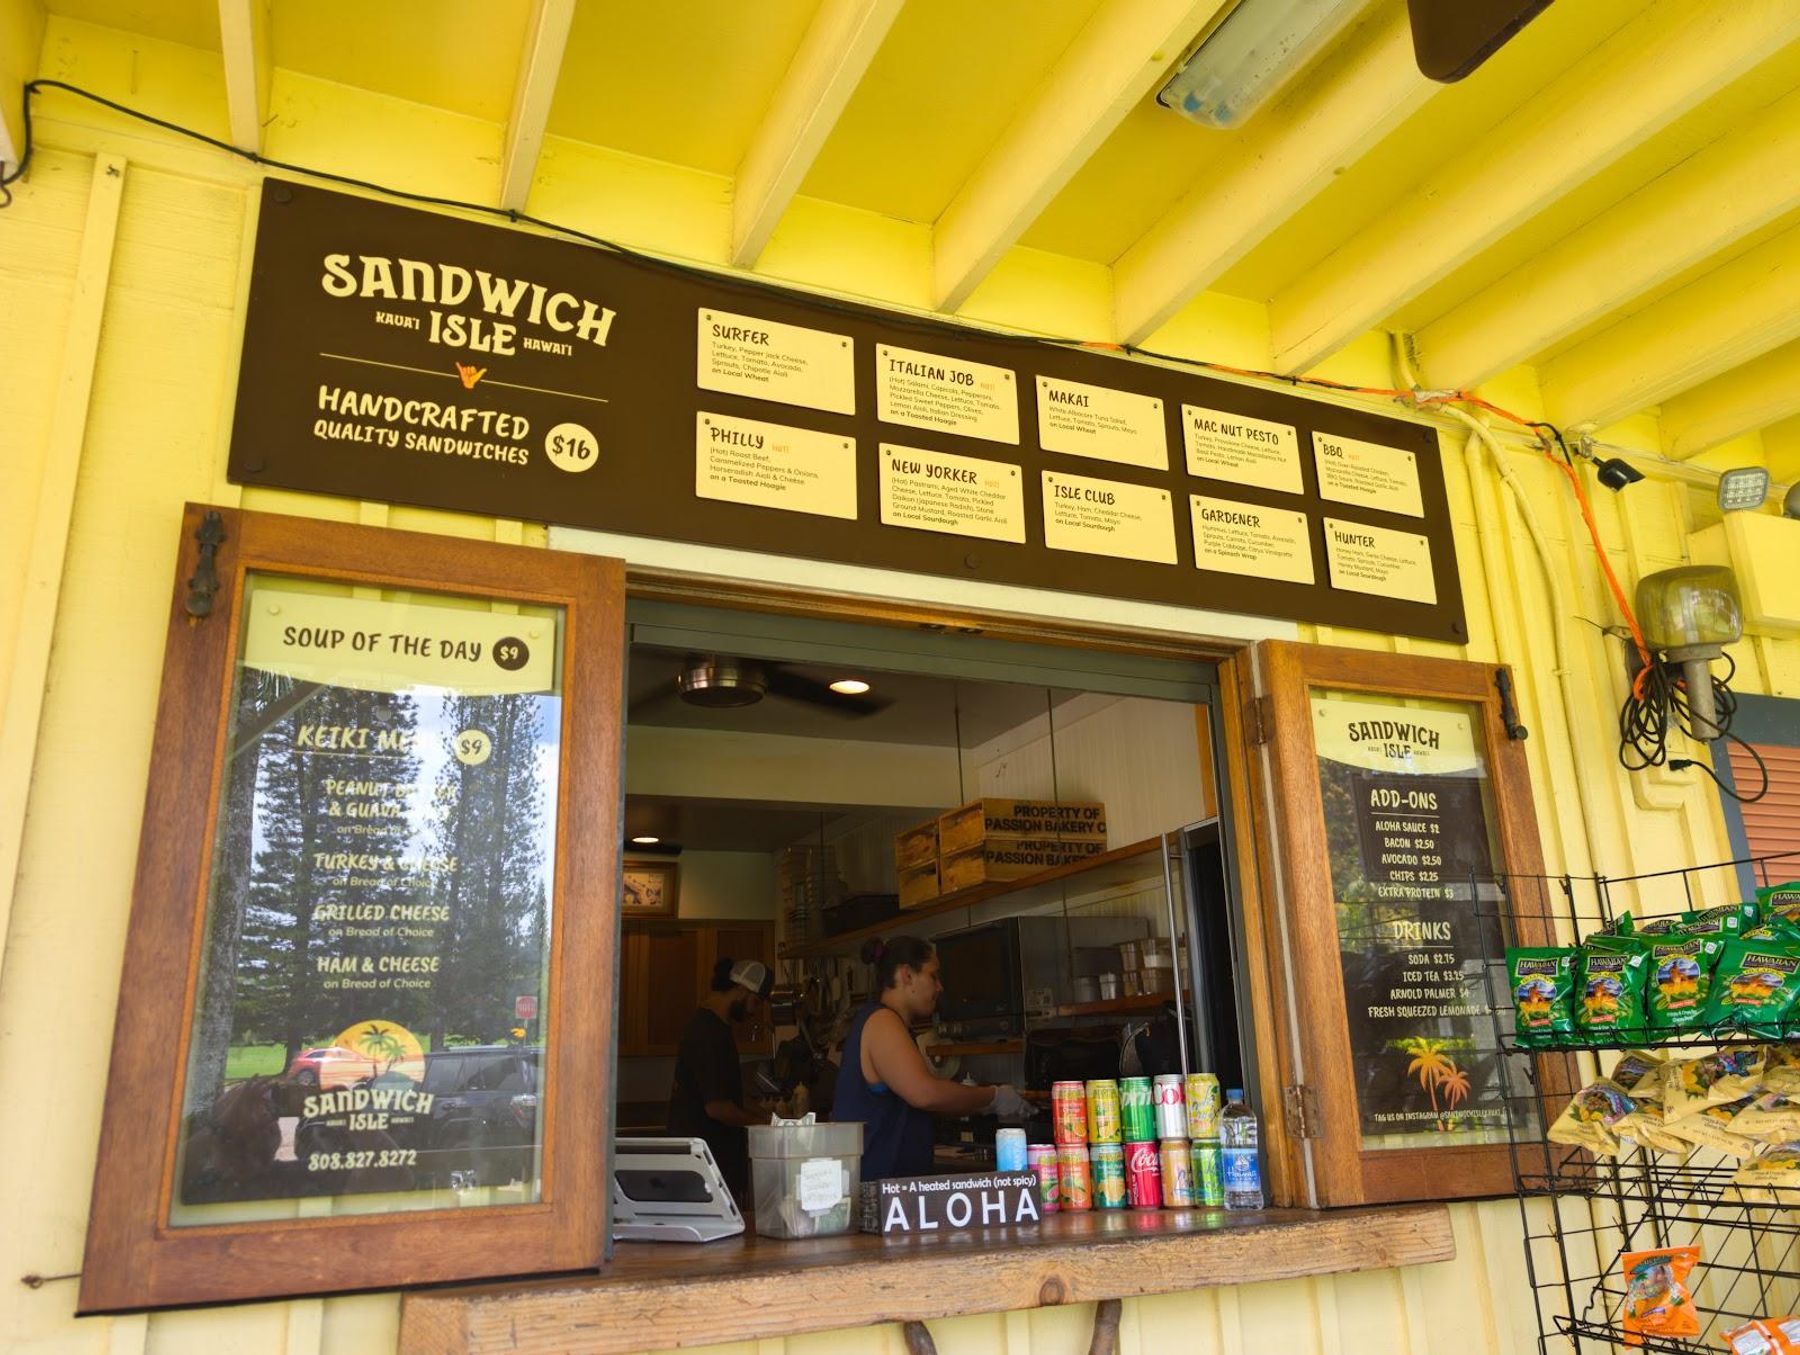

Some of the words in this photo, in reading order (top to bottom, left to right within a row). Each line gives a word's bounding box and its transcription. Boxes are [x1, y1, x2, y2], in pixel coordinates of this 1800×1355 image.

[322, 253, 616, 347] SANDWICH
[428, 310, 516, 356] ISLE
[712, 322, 769, 346] SURFER
[723, 368, 742, 377] Local
[744, 372, 768, 382] Wheat
[889, 357, 944, 381] ITALIAN
[949, 369, 973, 386] JOB
[1048, 388, 1089, 408] MAKAI
[318, 385, 530, 441] HANDCRAFTED
[710, 426, 763, 449] PHILLY
[1193, 417, 1217, 433] MAC
[1219, 422, 1243, 438] NUT
[1245, 427, 1278, 445] PESTO
[314, 420, 400, 448] QUALITY
[404, 432, 529, 466] SANDWICHES
[551, 434, 590, 460] $16
[1322, 443, 1343, 459] BBQ
[891, 457, 920, 475] NEW
[926, 463, 977, 484] YORKER
[710, 473, 719, 481] on
[728, 476, 757, 487] Toasted
[760, 480, 785, 491] Hoagie
[1054, 484, 1080, 500] ISLE
[1084, 489, 1115, 505] CLUB
[893, 510, 901, 518] on
[903, 511, 920, 520] Local
[923, 514, 958, 526] Sourdough
[1055, 517, 1063, 525] on
[1064, 519, 1080, 528] Local
[1082, 521, 1114, 532] Sourdough
[1201, 507, 1260, 528] GARDENER
[1334, 530, 1375, 548] HUNTER
[282, 627, 344, 648] SOUP
[352, 632, 382, 653] OF
[390, 635, 431, 657] THE
[439, 641, 482, 662] DAY
[499, 645, 519, 661] $9
[298, 726, 369, 749] KEIKI
[461, 740, 483, 756] $9
[1348, 721, 1440, 750] SANDWICH
[1384, 743, 1412, 759] ISLE
[326, 780, 392, 797] PEANUT
[1371, 789, 1438, 810] ADD-ONS
[329, 803, 341, 816] &
[346, 802, 401, 818] GUAVA
[1014, 805, 1080, 819] PROPERTY
[1083, 808, 1100, 819] OF
[985, 818, 1042, 831] PASSION
[1045, 820, 1094, 833] BAKERY
[1376, 821, 1401, 831] ALOHA
[1403, 822, 1426, 833] SAUCE
[1431, 824, 1440, 834] $2
[1016, 840, 1083, 853] PROPERTY
[1087, 843, 1103, 854] OF
[1385, 838, 1411, 848] BACON
[313, 853, 379, 871] TURKEY
[383, 855, 394, 871] &
[985, 850, 1044, 865] PASSION
[1382, 854, 1418, 865] AVOCADO
[332, 878, 346, 886] on
[350, 877, 382, 887] Bread
[388, 877, 399, 887] of
[1390, 870, 1415, 881] CHIPS
[1378, 887, 1406, 897] EXTRA
[1406, 887, 1440, 898] PROTEIN
[314, 904, 385, 922] GRILLED
[390, 904, 450, 921] CHEESE
[328, 929, 342, 937] on
[346, 927, 380, 936] Bread
[383, 927, 394, 936] of
[398, 927, 434, 937] Choice
[1393, 921, 1451, 940] DRINKS
[317, 956, 357, 973] HAM
[362, 957, 374, 973] &
[379, 956, 440, 972] CHEESE
[1408, 954, 1430, 965] SODA
[1434, 953, 1455, 964] $2.75
[1520, 960, 1556, 968] HAWAIIAN
[1591, 957, 1628, 965] HAWAIIAN
[1748, 955, 1797, 966] HAWAIIAN
[323, 980, 339, 988] on
[342, 979, 376, 989] Bread
[379, 979, 391, 989] of
[394, 978, 431, 988] Choice
[1403, 972, 1422, 982] ICED
[1424, 971, 1440, 982] TEA
[1390, 988, 1422, 1000] ARNOLD
[1424, 988, 1456, 999] PALMER
[1368, 1006, 1395, 1018] FRESH
[1397, 1006, 1437, 1018] SQUEEZED
[1440, 1006, 1480, 1016] LEMONADE
[304, 1089, 435, 1118] SANDWICH
[349, 1113, 389, 1131] ISLE
[308, 1149, 417, 1171] 808.827.8272
[882, 1183, 900, 1194] Hot
[909, 1182, 917, 1192] A
[919, 1180, 950, 1192] heated
[952, 1178, 992, 1190] sandwich
[994, 1176, 1012, 1189] (not
[1013, 1174, 1037, 1189] spicy)
[884, 1188, 1039, 1232] ALOHA
